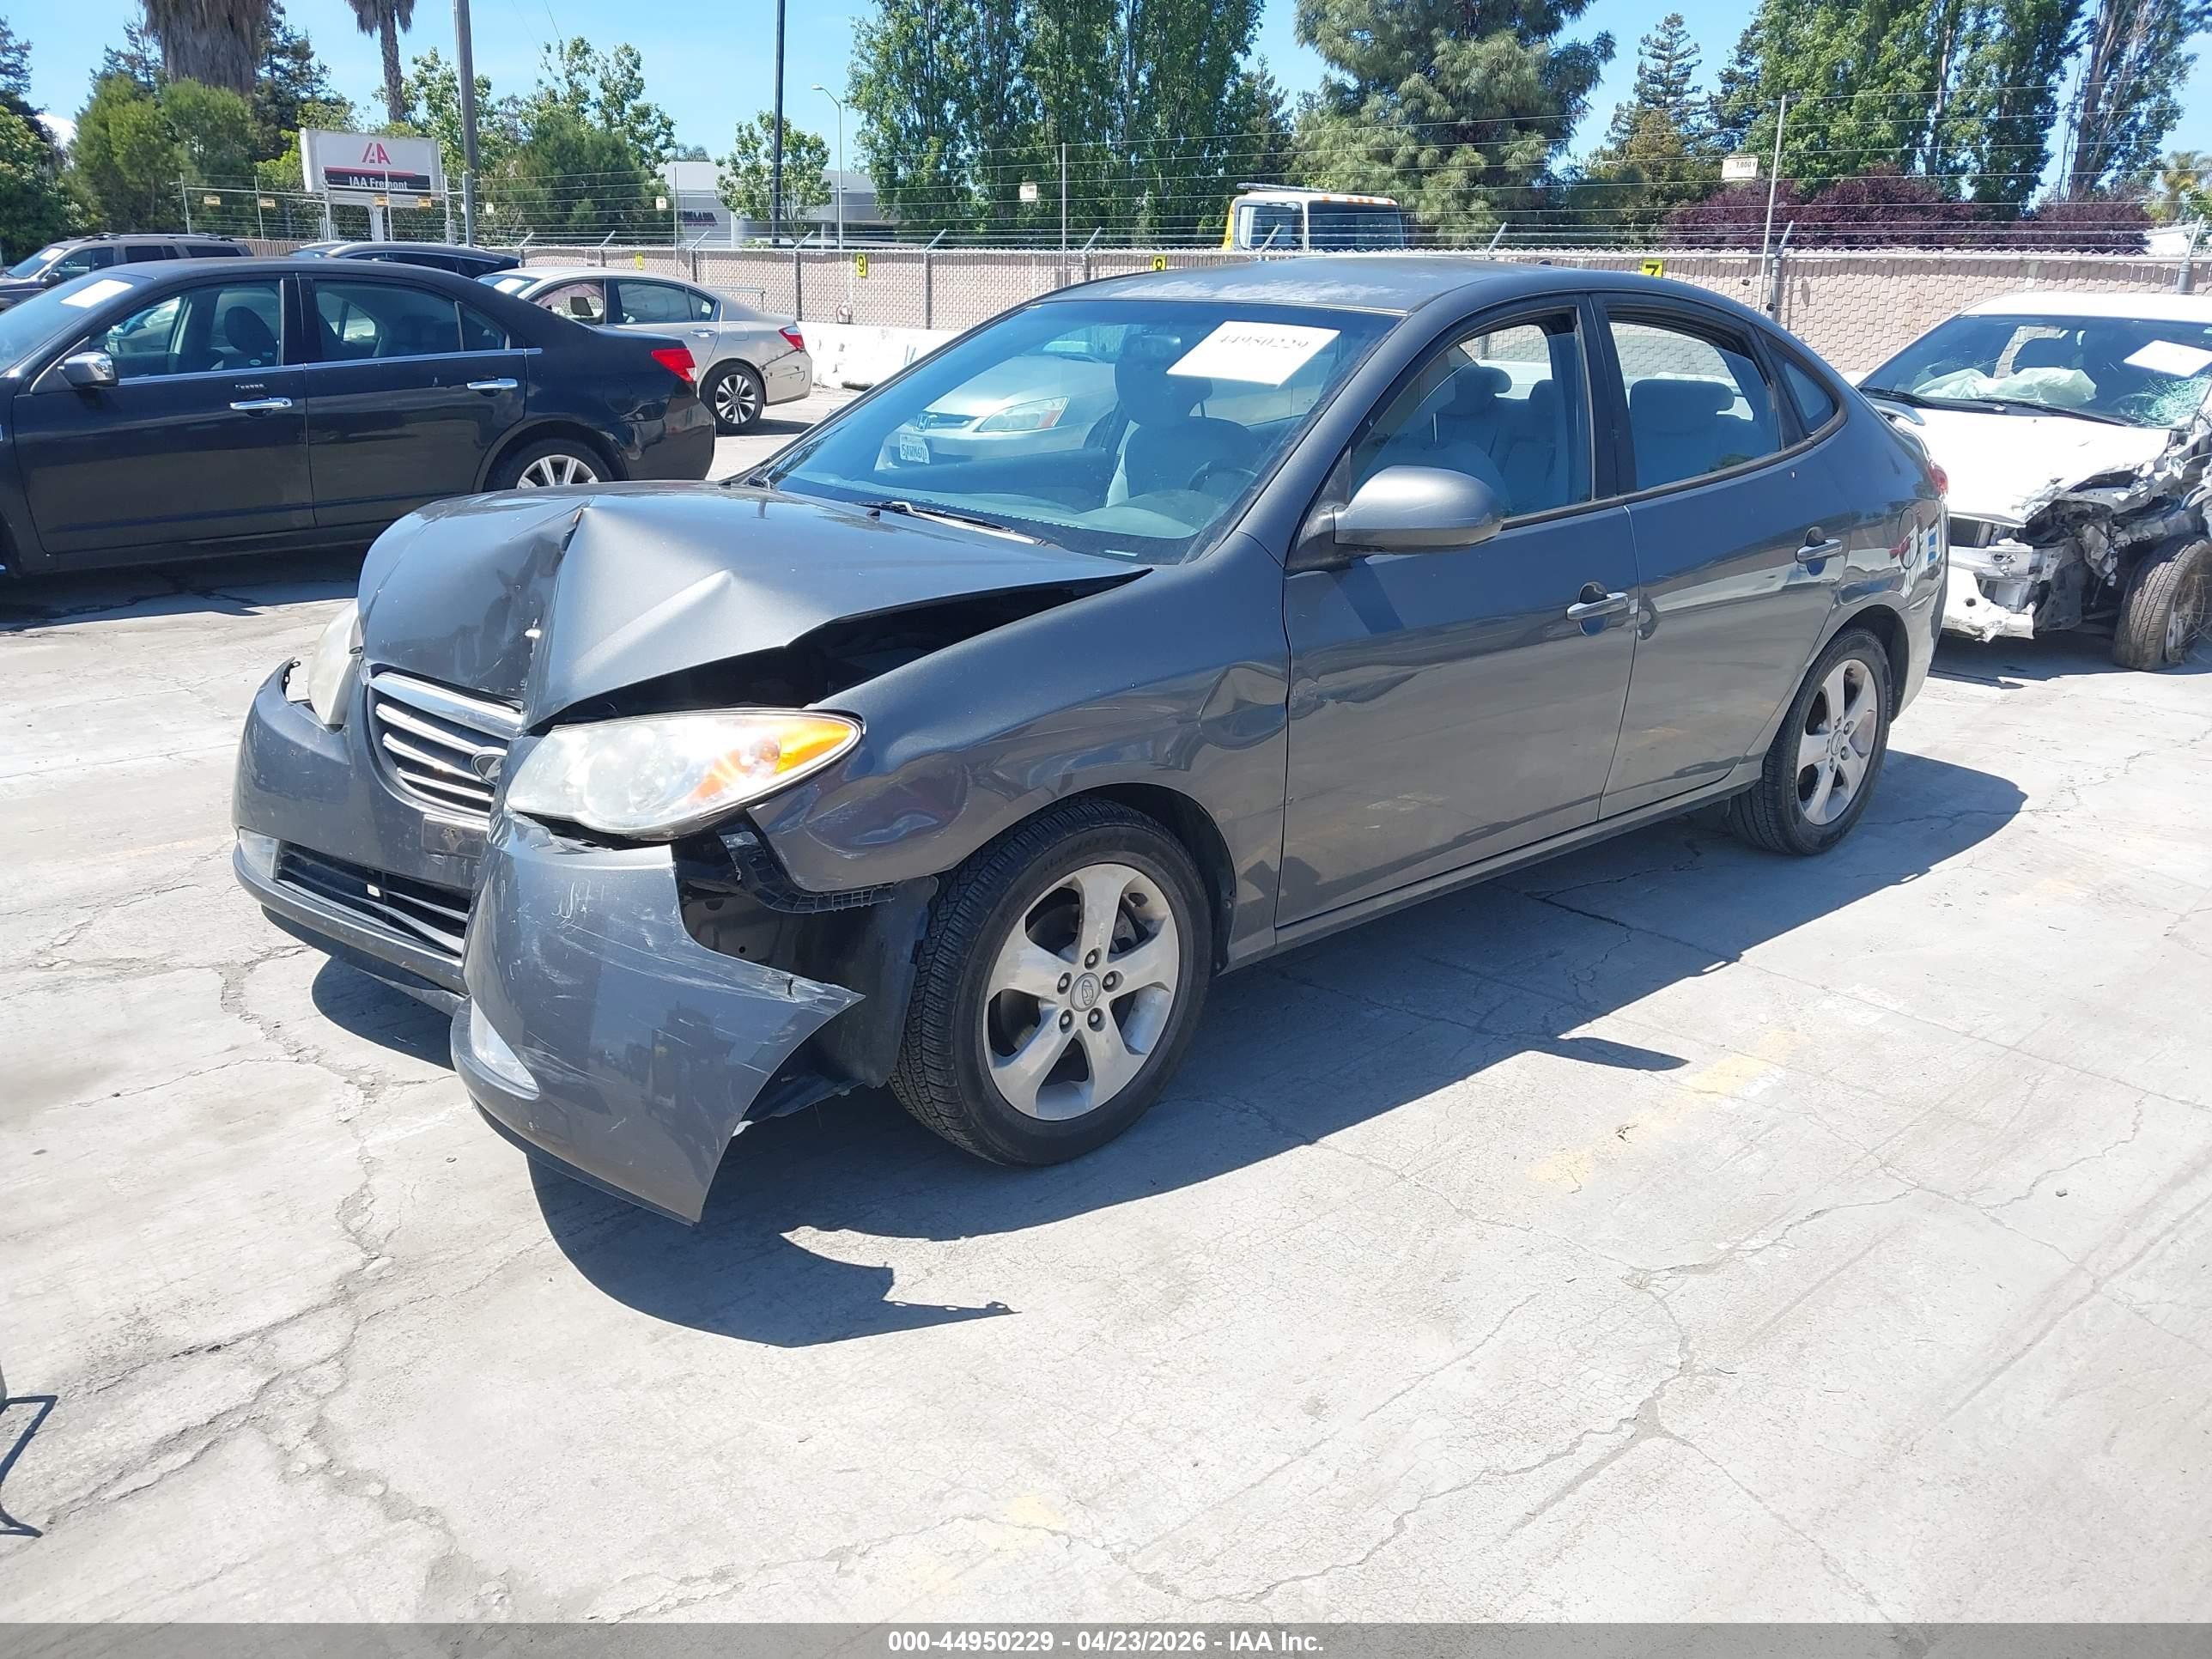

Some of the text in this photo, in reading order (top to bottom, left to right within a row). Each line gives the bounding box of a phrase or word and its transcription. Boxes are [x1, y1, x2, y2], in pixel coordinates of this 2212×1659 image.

[349, 175, 408, 191] IAA Fremont
[858, 255, 865, 273] 9
[1644, 264, 1660, 276] 7
